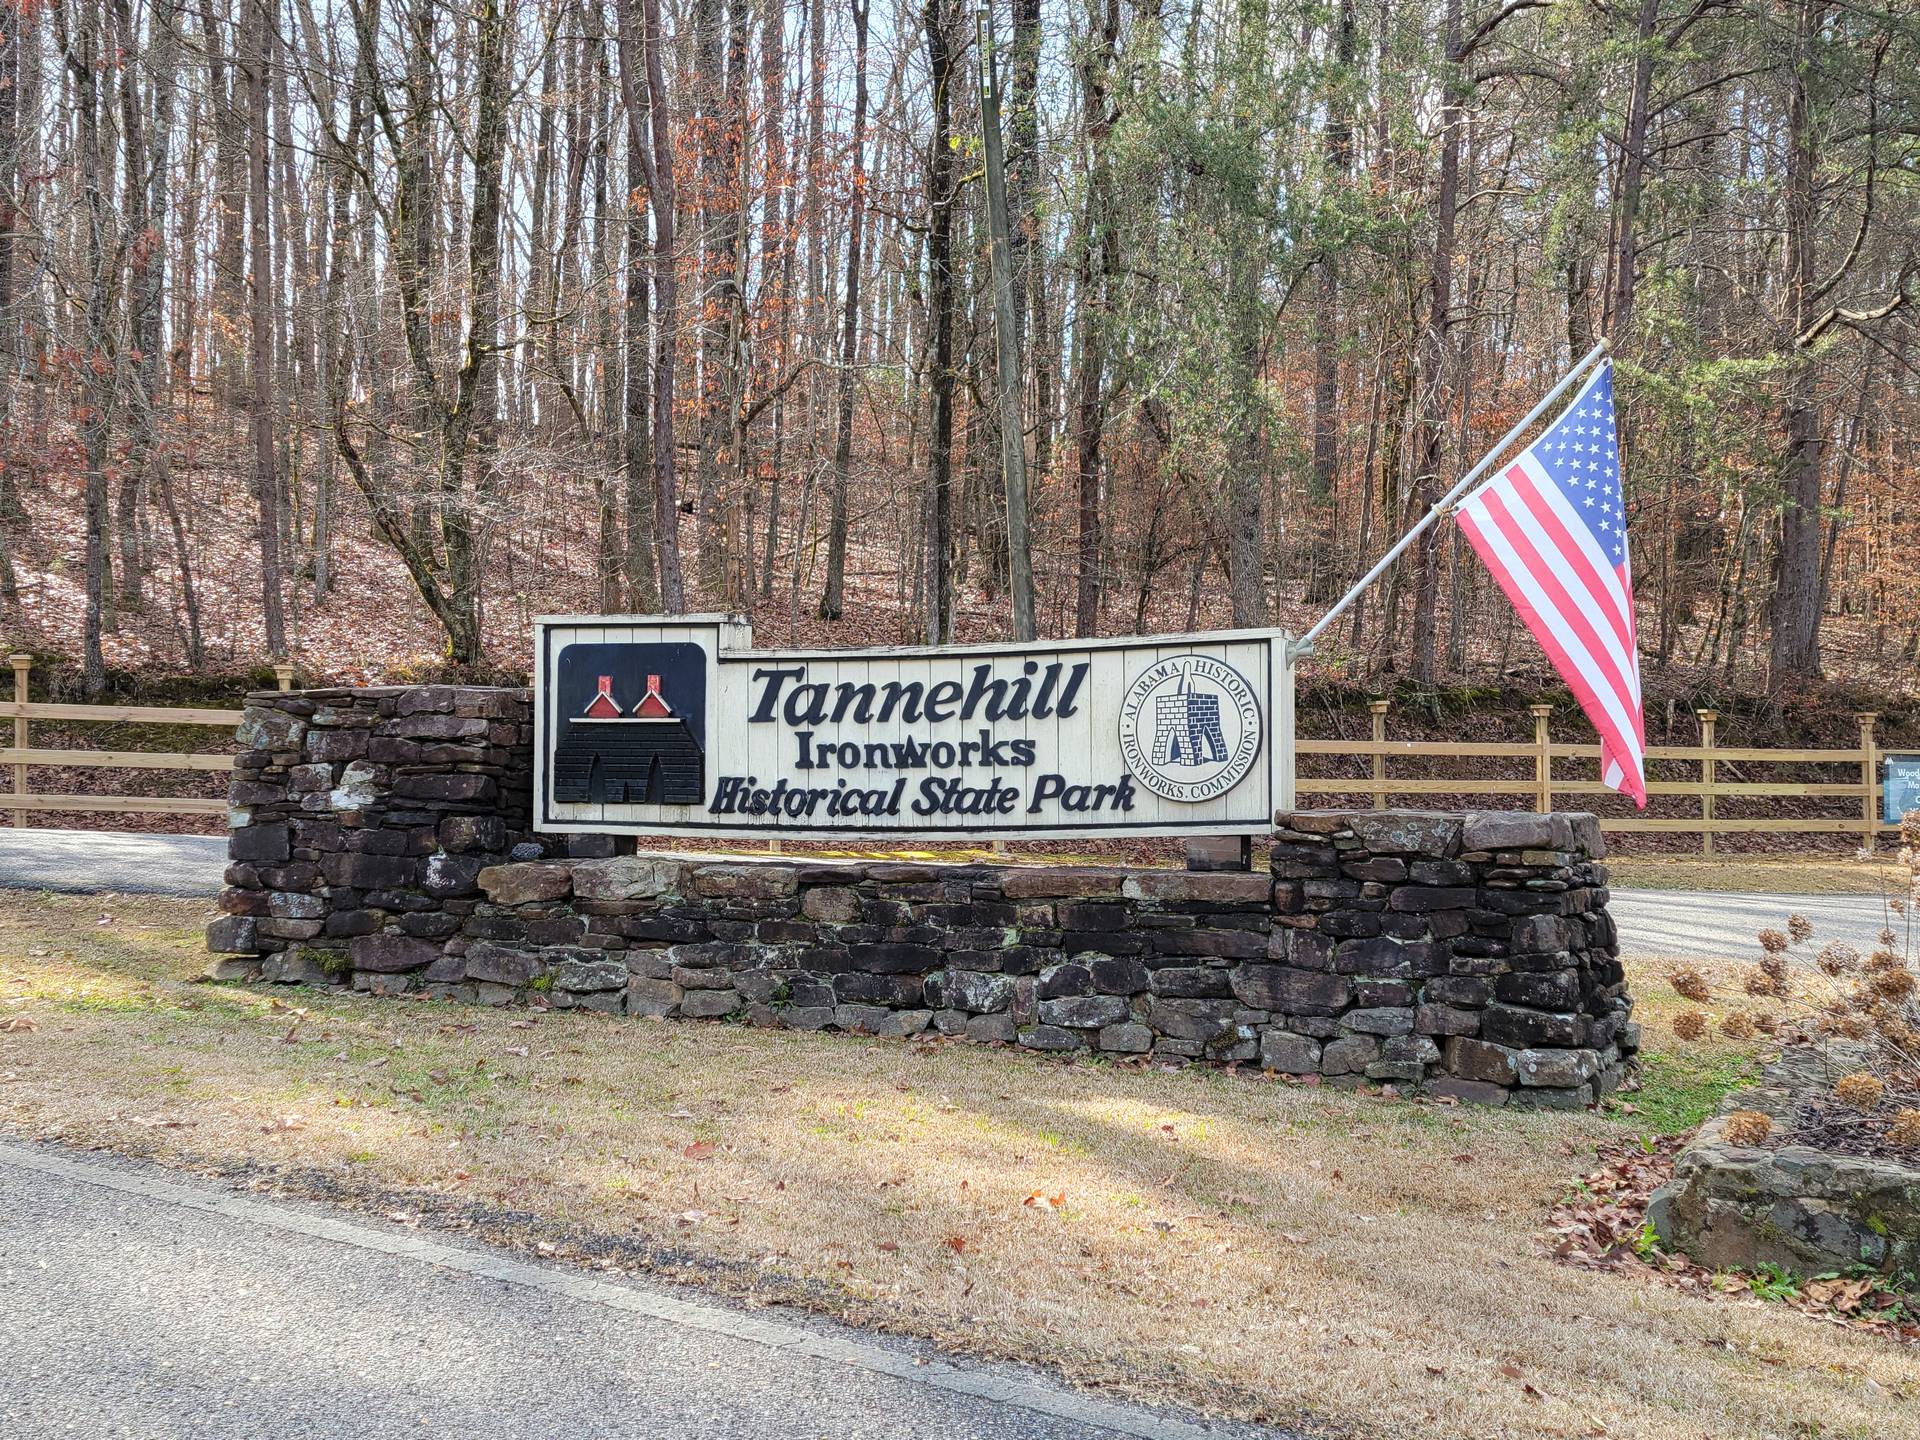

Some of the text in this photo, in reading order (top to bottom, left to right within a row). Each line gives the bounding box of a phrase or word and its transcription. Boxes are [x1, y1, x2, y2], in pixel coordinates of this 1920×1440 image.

[748, 661, 1090, 725] Tannehill
[1126, 660, 1256, 721] ALABAMA HISTORIC
[795, 729, 1037, 769] Ironworks
[1123, 730, 1257, 799] IRONWORKS COMMISSION
[709, 773, 1137, 818] Historical State Park
